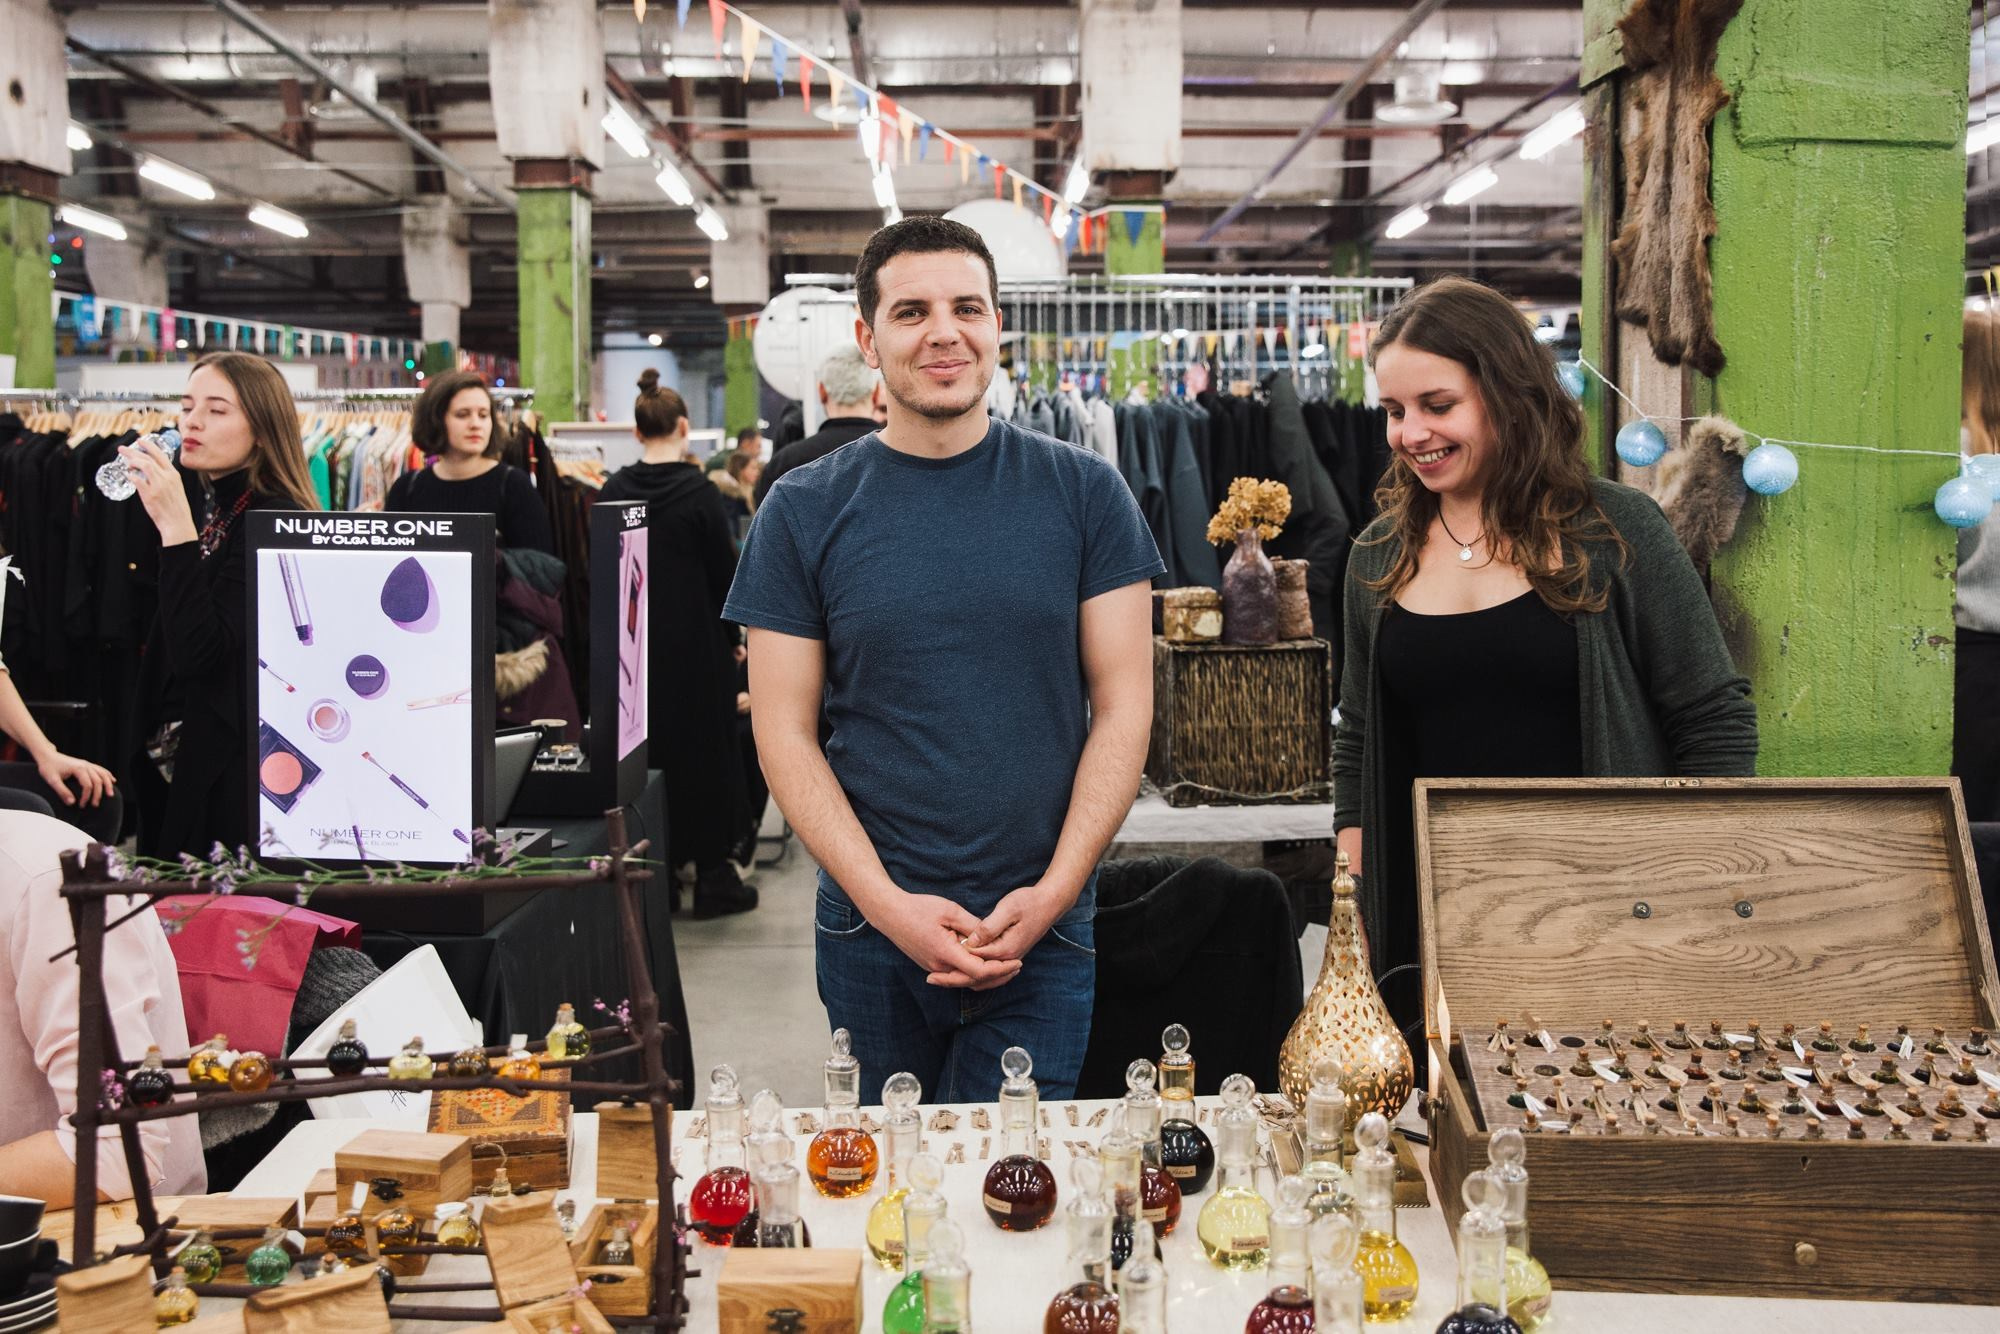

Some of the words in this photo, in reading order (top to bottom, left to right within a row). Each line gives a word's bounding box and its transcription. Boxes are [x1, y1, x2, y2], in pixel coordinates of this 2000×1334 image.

[275, 519, 389, 536] NUMBER
[394, 520, 453, 536] ONE
[385, 829, 423, 840] ONE
